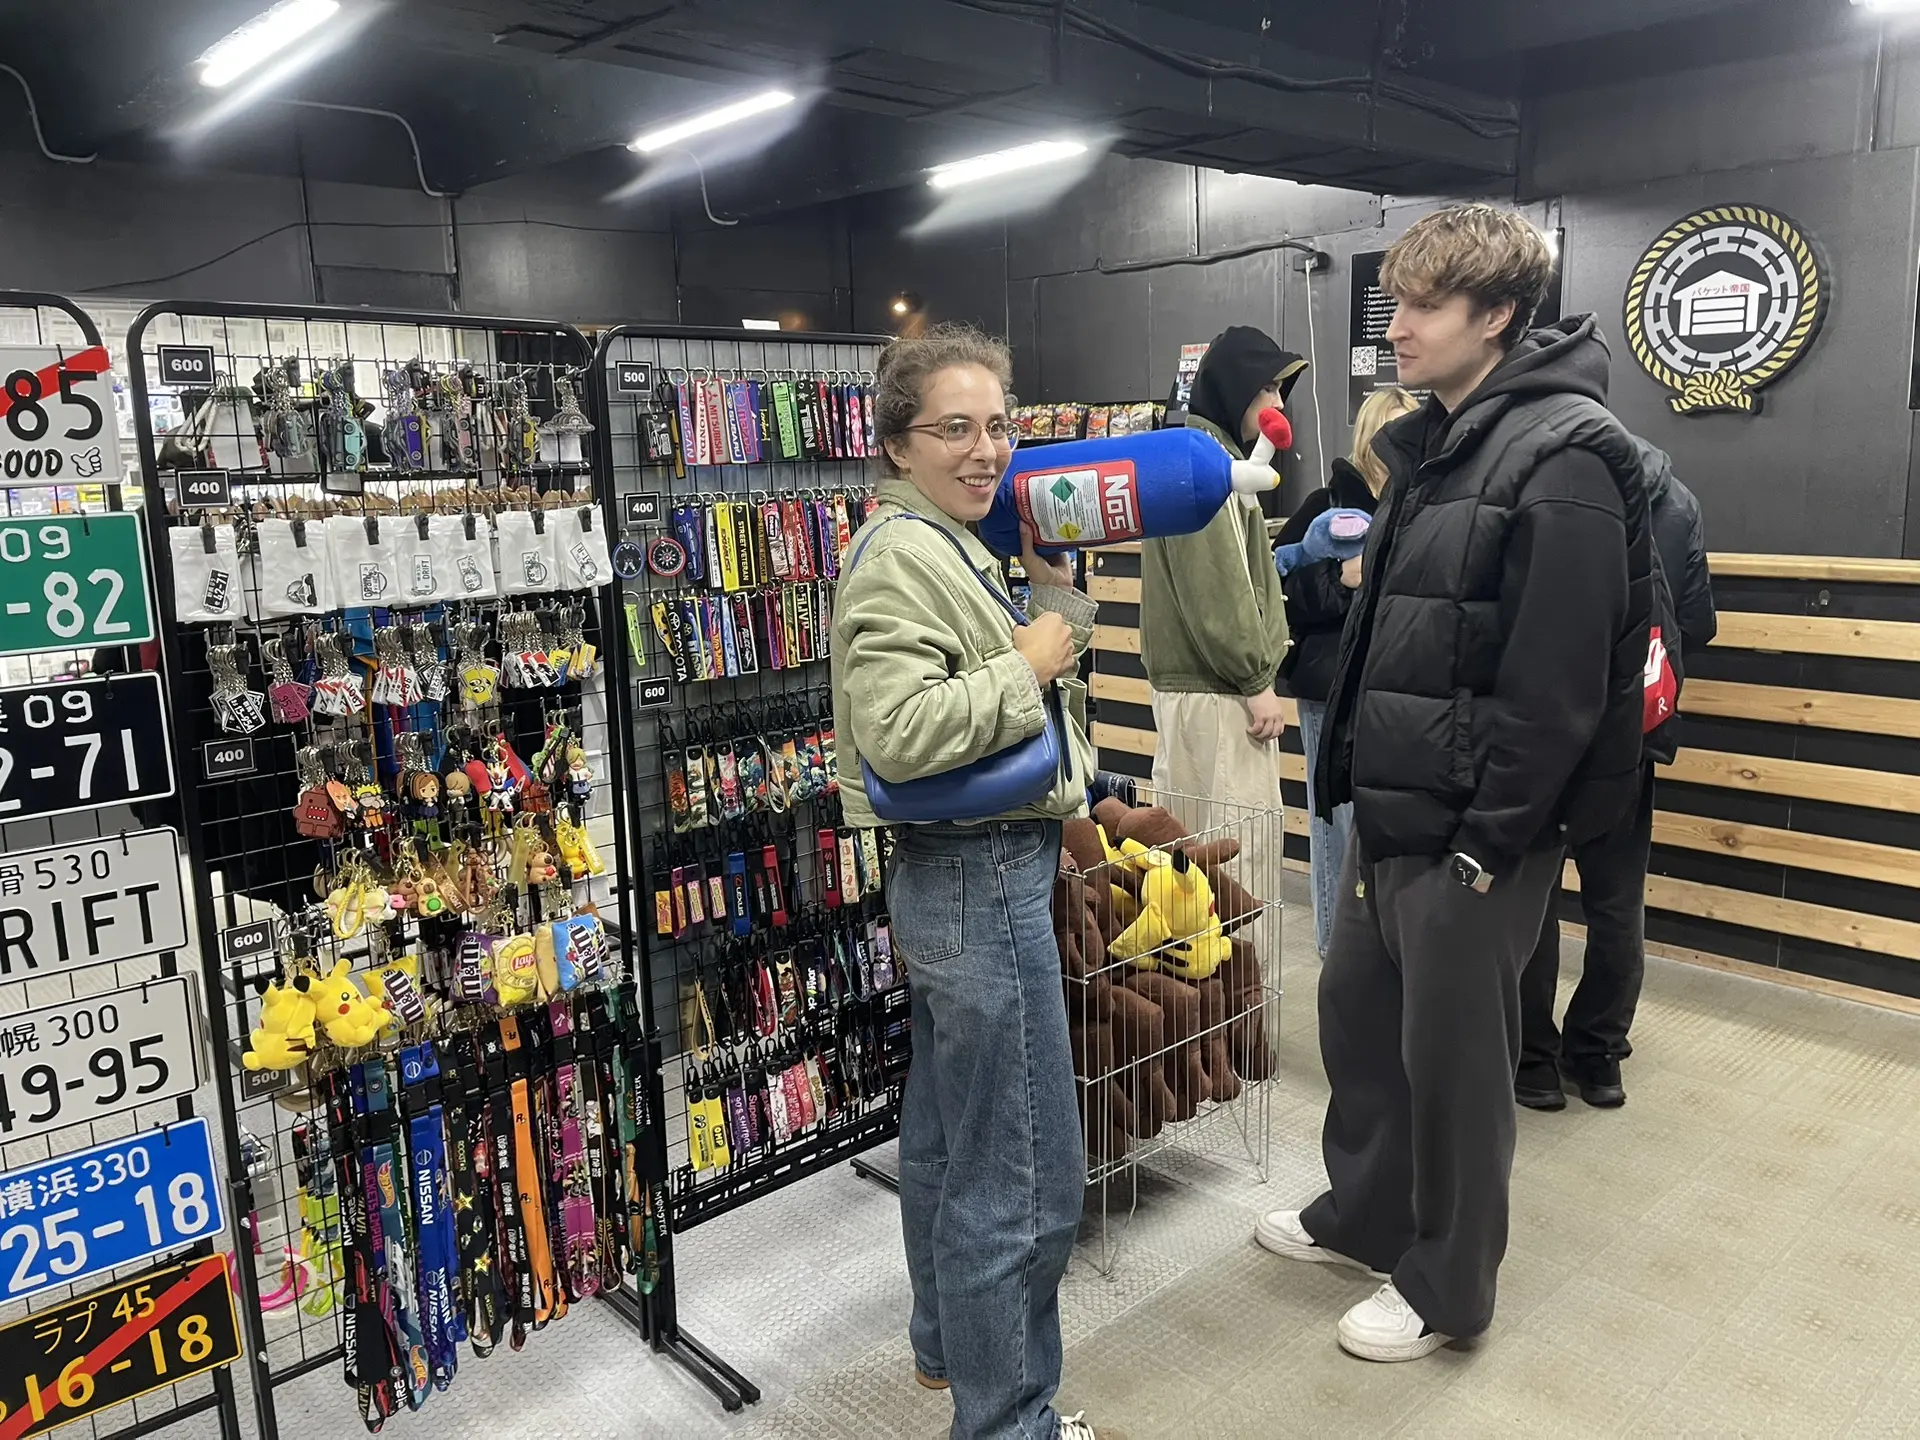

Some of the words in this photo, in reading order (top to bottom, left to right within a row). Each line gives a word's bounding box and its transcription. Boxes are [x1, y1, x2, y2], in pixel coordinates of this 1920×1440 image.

[171, 358, 203, 372] 600
[624, 372, 645, 383] 500
[681, 405, 695, 459] NISSAN
[709, 404, 724, 456] MITSUBISHI
[728, 408, 742, 458] SUBARU
[800, 404, 816, 449] TEIN
[0, 448, 63, 478] OOD
[188, 481, 220, 495] 400
[632, 502, 654, 514] 400
[1, 525, 71, 562] 09
[737, 520, 746, 548] STREET
[421, 560, 431, 580] DRIFT
[739, 549, 750, 581] VETERAN
[23, 691, 93, 728] 09
[644, 686, 666, 699] 600
[214, 748, 245, 764] 400
[34, 849, 110, 890] 530
[825, 863, 833, 889] SUZUKI
[736, 886, 745, 917] LEXUS
[233, 931, 264, 949] 600
[48, 1004, 119, 1047] 300
[250, 1070, 280, 1087] 500
[550, 1115, 560, 1139] JDM
[714, 1127, 724, 1148] OMP
[81, 1146, 150, 1193] 330
[363, 1162, 379, 1211] BUCKETS
[418, 1169, 434, 1225] NISSAN
[655, 1190, 668, 1237] MONSTER
[1, 1172, 210, 1294] 25-18
[369, 1212, 383, 1251] EMPIRE
[34, 1302, 98, 1354] ラプ
[112, 1285, 156, 1323] 45
[428, 1289, 438, 1346] NISSAN
[345, 1313, 359, 1372] NISSAN
[24, 1314, 214, 1423] 16-18
